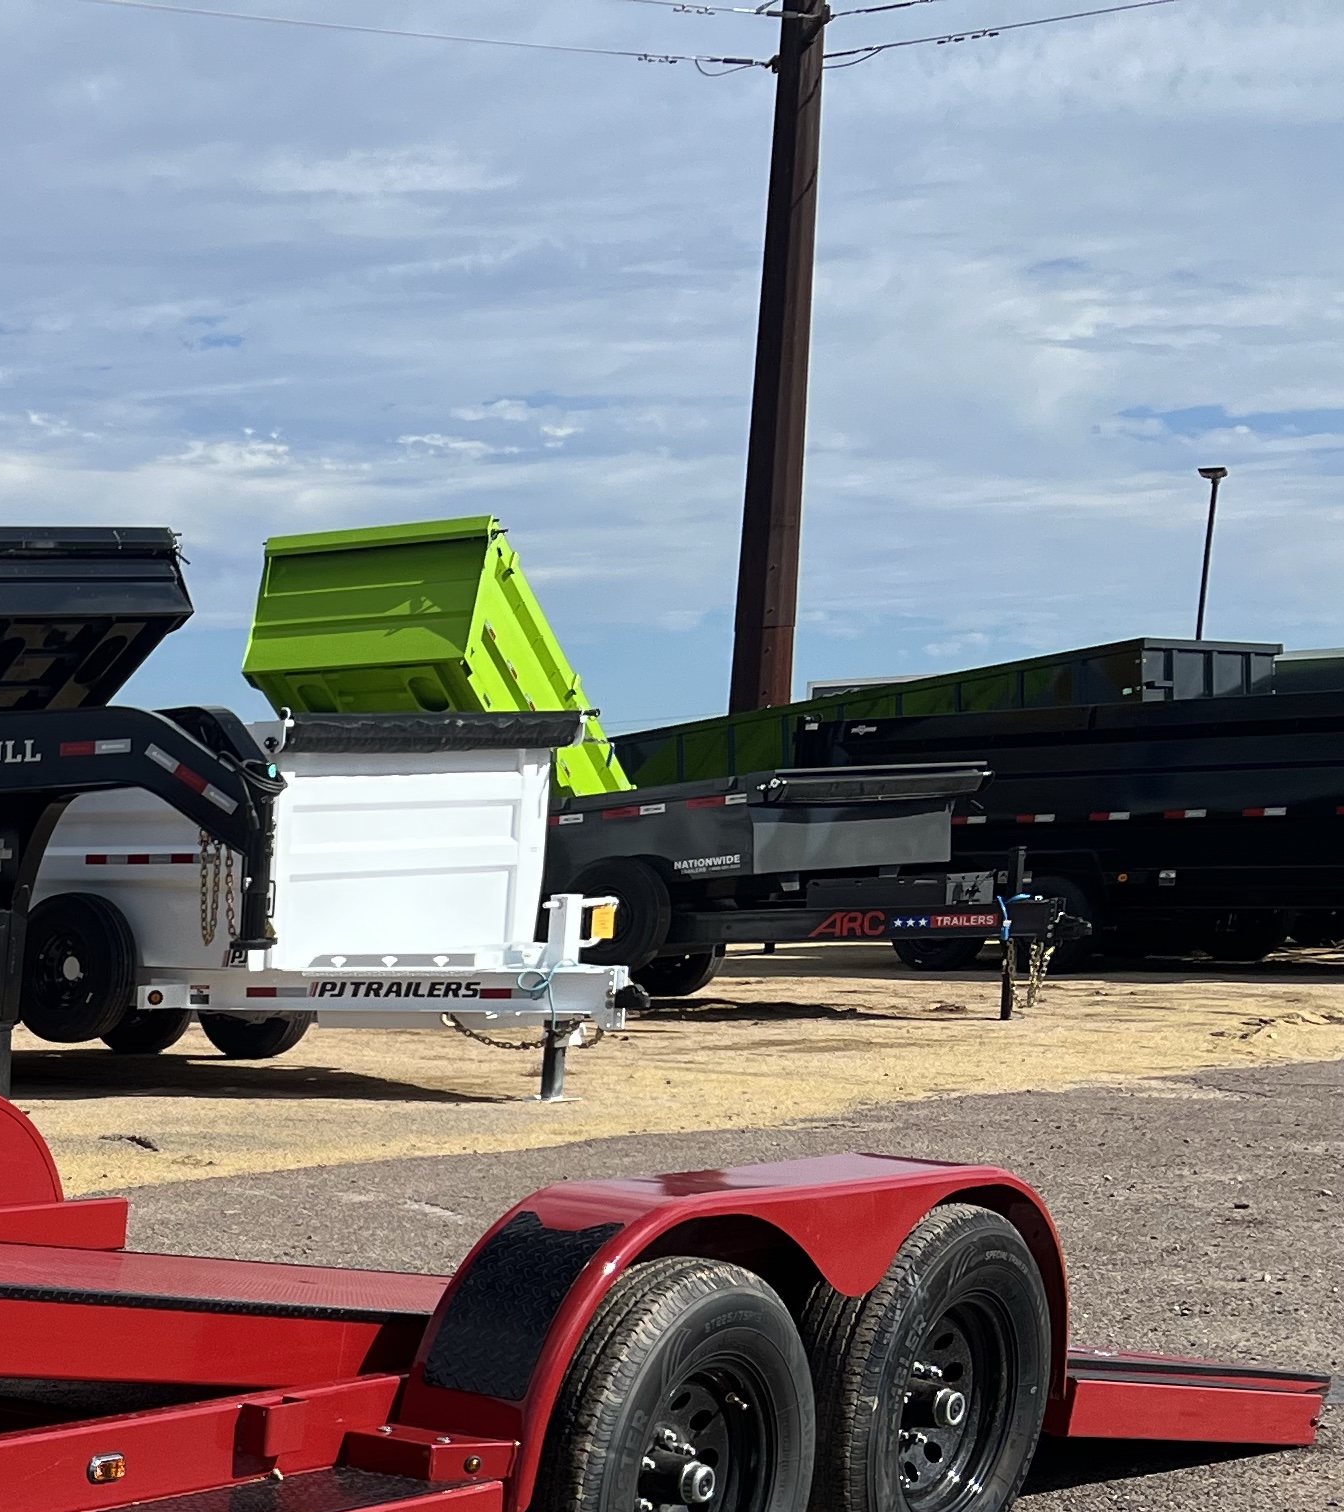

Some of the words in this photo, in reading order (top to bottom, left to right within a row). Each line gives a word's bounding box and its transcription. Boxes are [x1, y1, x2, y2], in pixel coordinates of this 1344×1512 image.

[673, 854, 741, 870] NATIONWIDE
[807, 910, 886, 937] ARC
[935, 915, 995, 927] TRAILERS
[350, 981, 482, 998] TRAILERS
